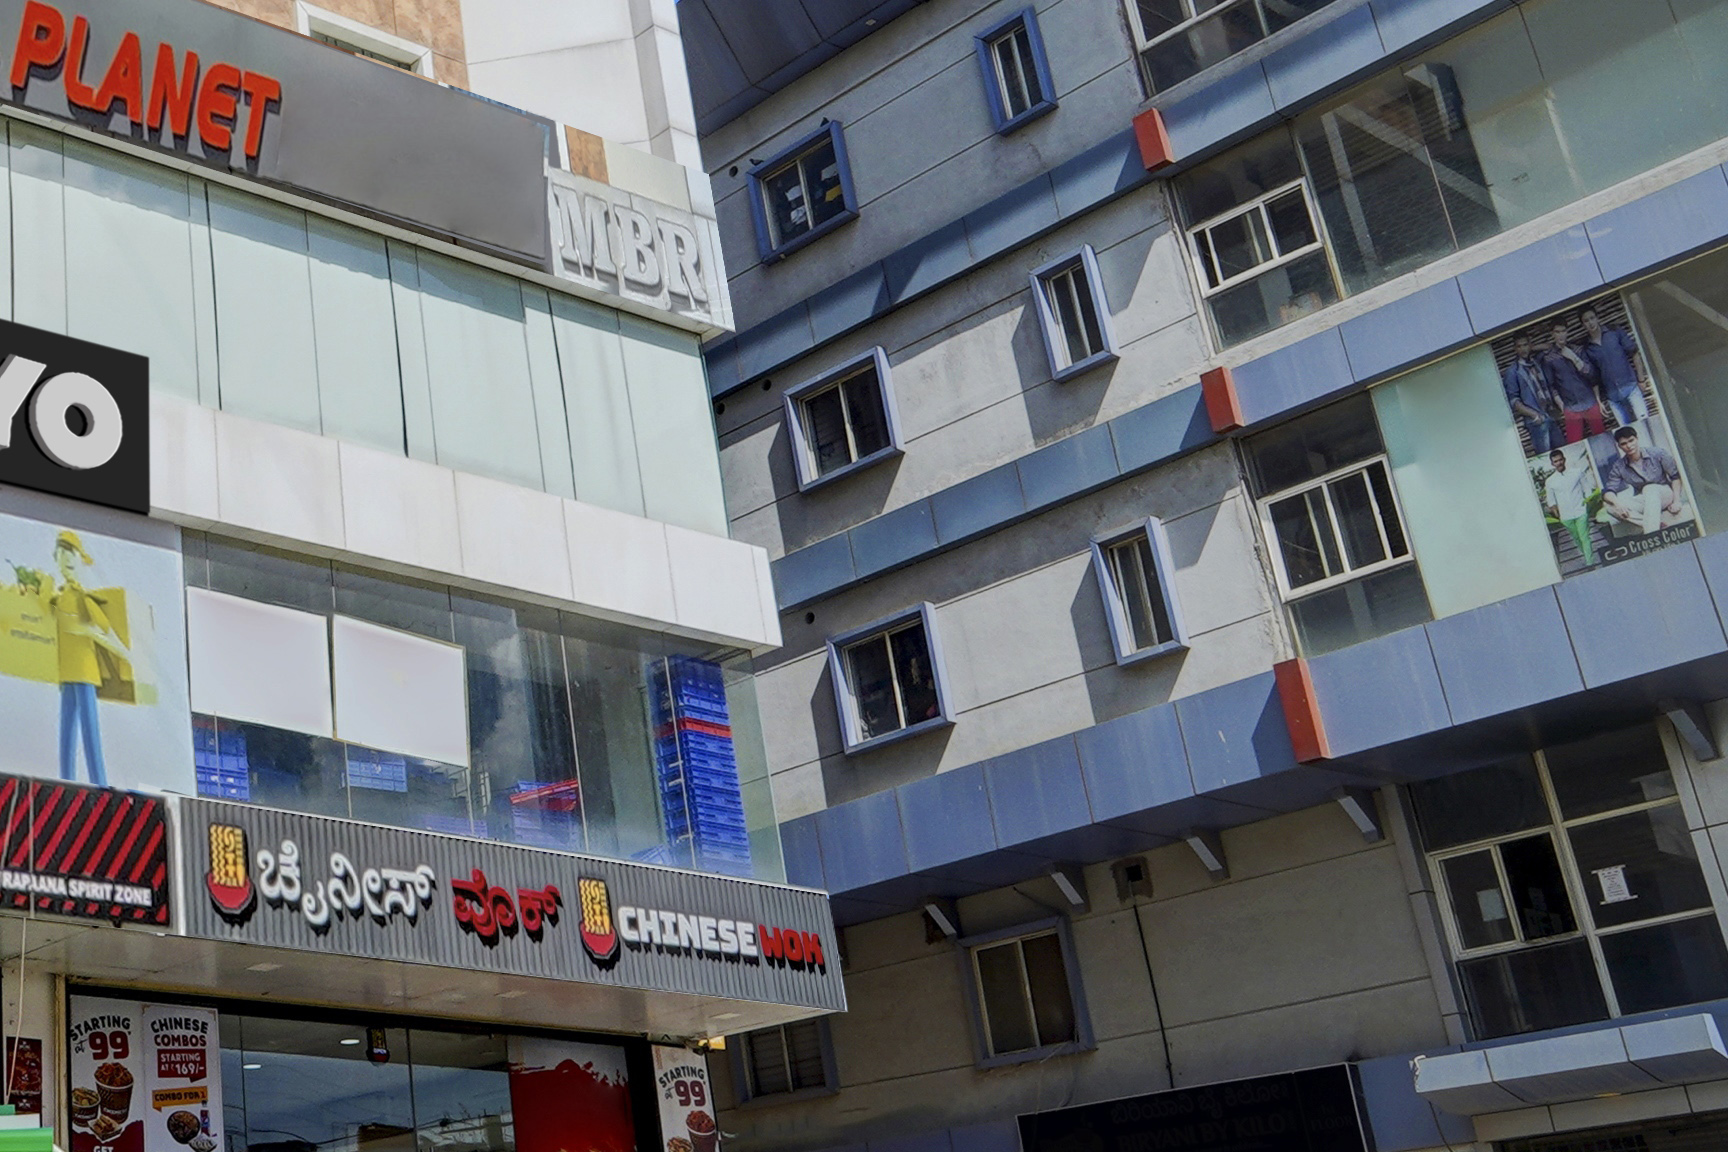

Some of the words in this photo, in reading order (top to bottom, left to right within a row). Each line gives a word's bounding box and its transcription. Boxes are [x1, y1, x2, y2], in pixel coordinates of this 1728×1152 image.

[10, 0, 282, 158] PLANET
[551, 183, 709, 304] MBR
[1628, 535, 1661, 554] Cross
[1662, 526, 1691, 543] Color
[68, 878, 114, 901] SPIRIT
[114, 885, 153, 907] ZONE
[617, 905, 758, 957] CHINESE
[758, 923, 825, 966] WOK
[71, 1015, 131, 1041] STARTING
[150, 1016, 209, 1035] CHINESE
[154, 1034, 207, 1048] COMBOS
[160, 1053, 201, 1062] STARTING
[160, 1064, 169, 1072] AT
[658, 1065, 706, 1089] STARTING
